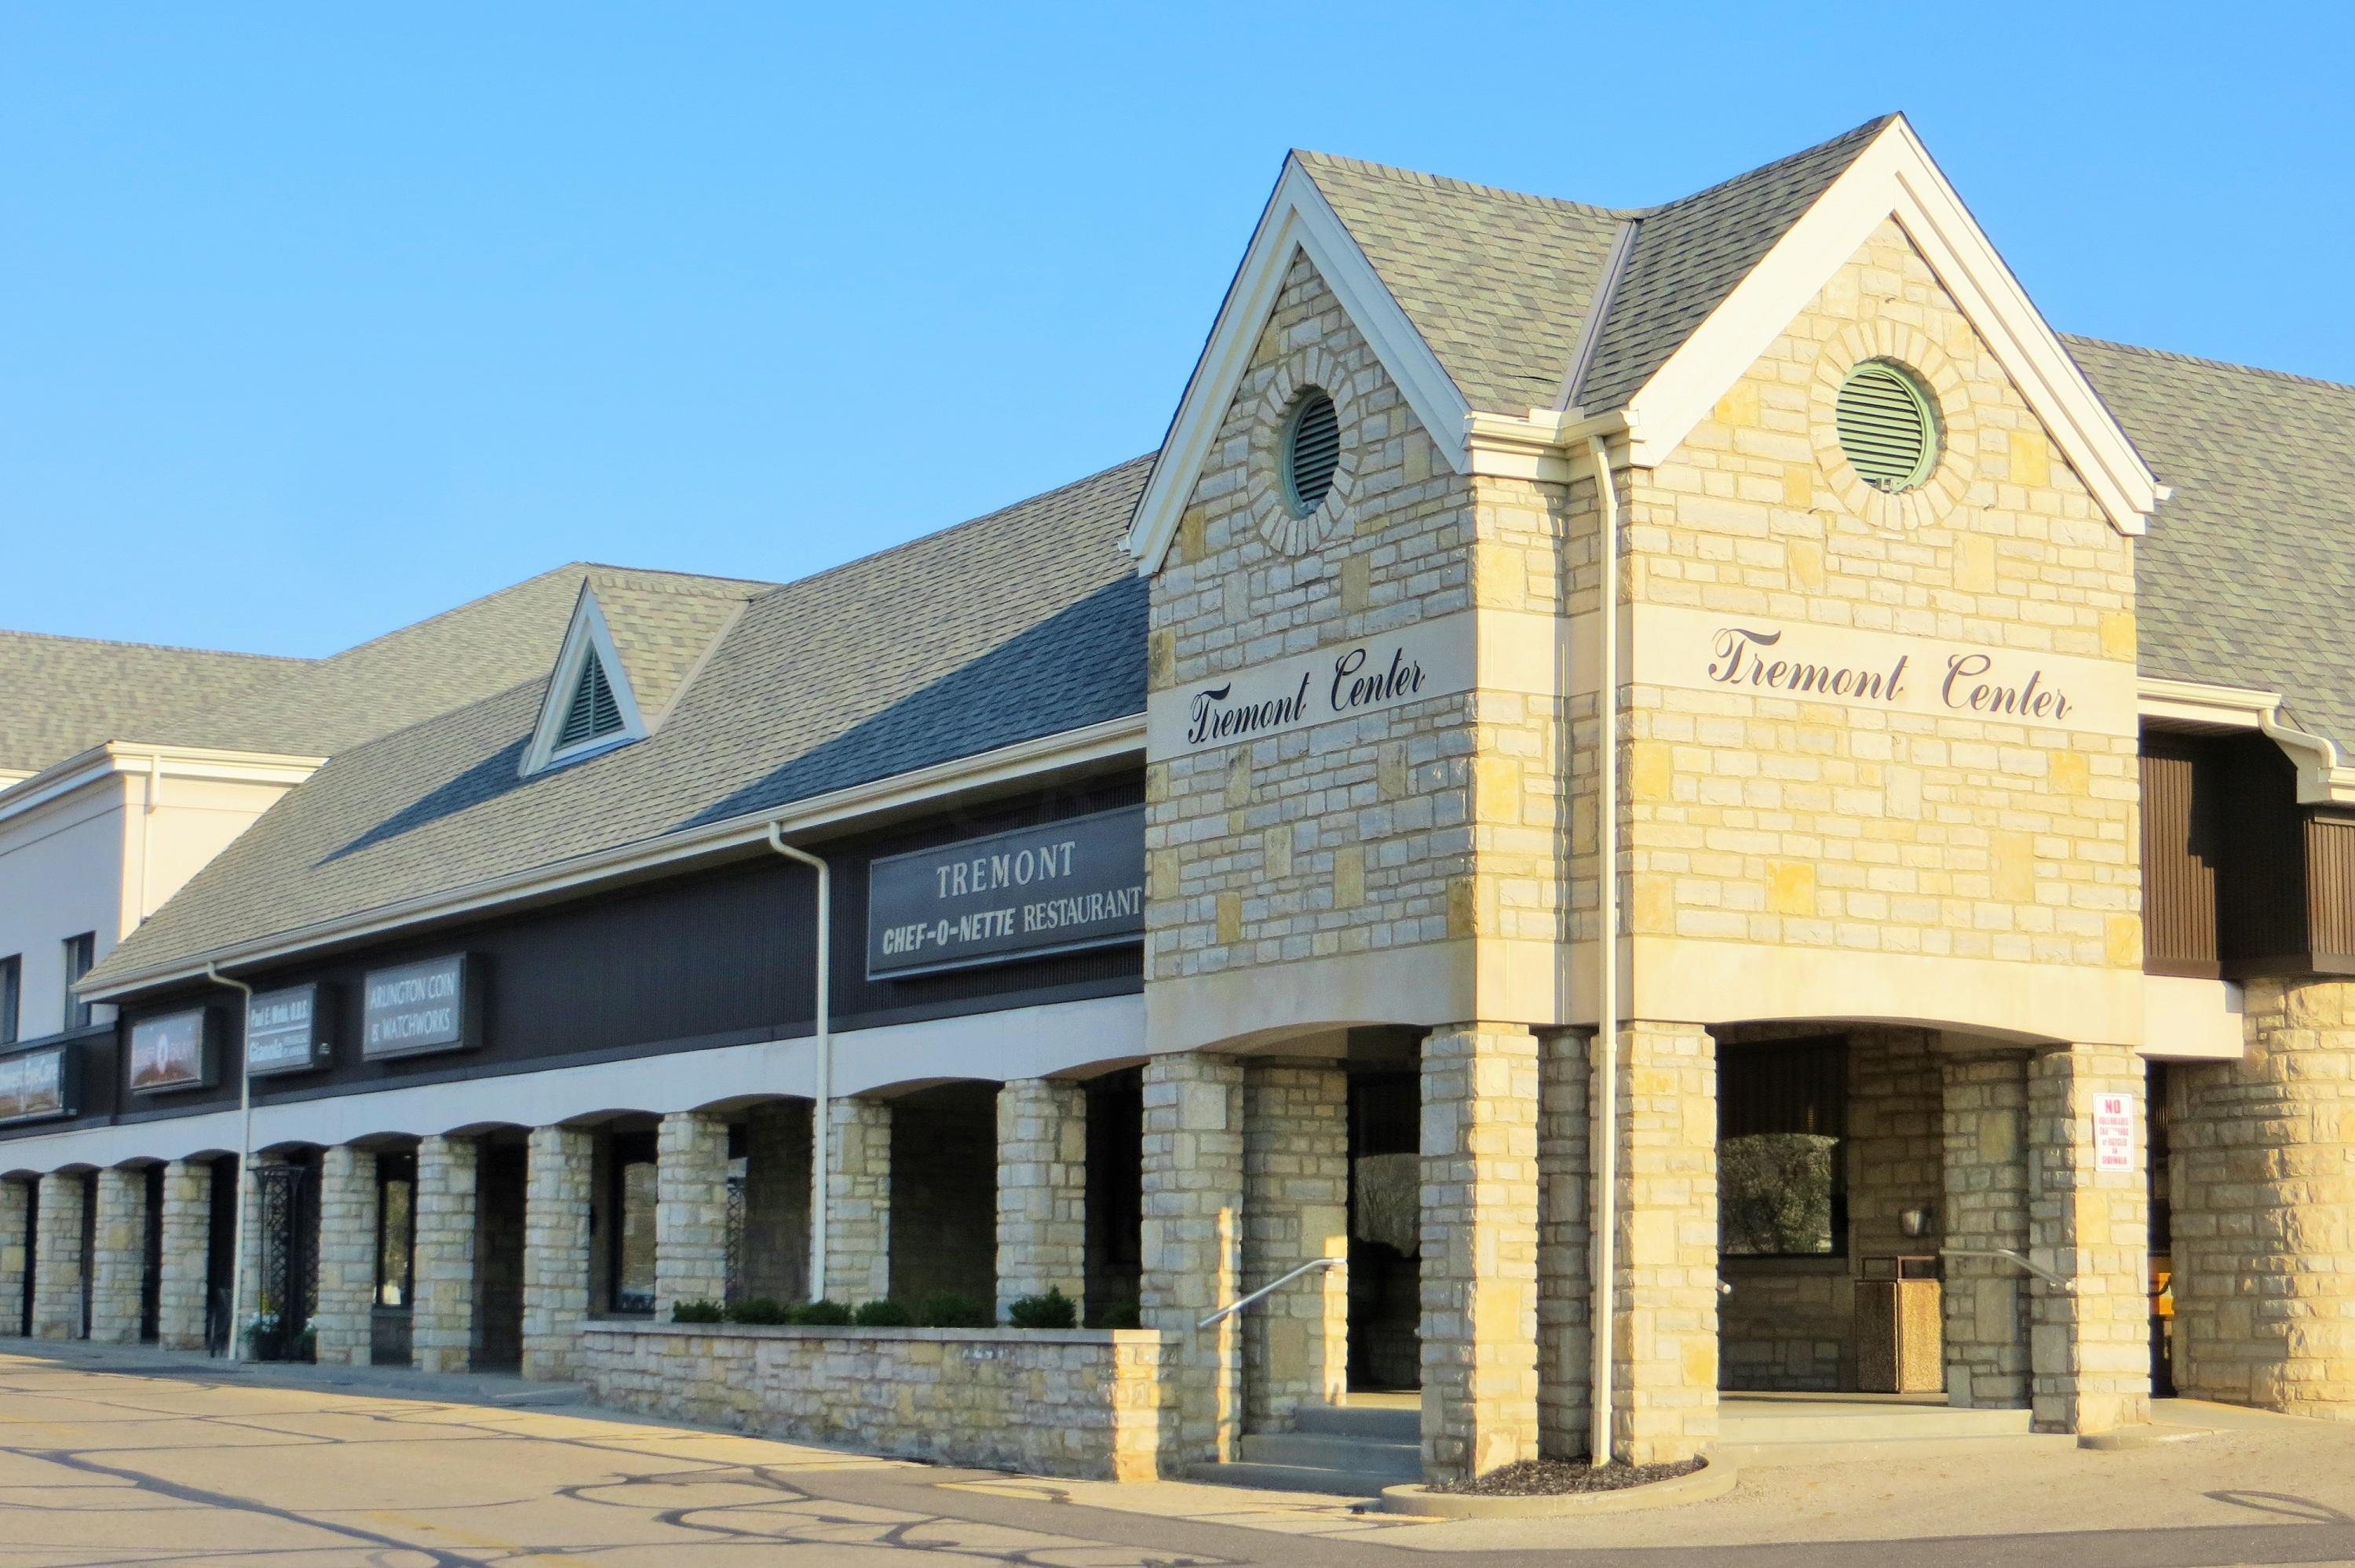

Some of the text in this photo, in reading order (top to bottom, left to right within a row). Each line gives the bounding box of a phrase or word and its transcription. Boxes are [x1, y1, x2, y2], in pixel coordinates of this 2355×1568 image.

[1188, 647, 1426, 744] Tremont Center
[1707, 627, 2073, 720] Tremont Center
[937, 841, 1076, 899] TREMONT
[882, 886, 1143, 955] CHEF-O-NETTE RESTAURANT
[370, 972, 455, 1010] ARLINGTON COIN
[382, 1008, 451, 1040] WATCHWORKS
[2105, 1099, 2122, 1114] NO
[2101, 1156, 2127, 1165] SIDEWALK
